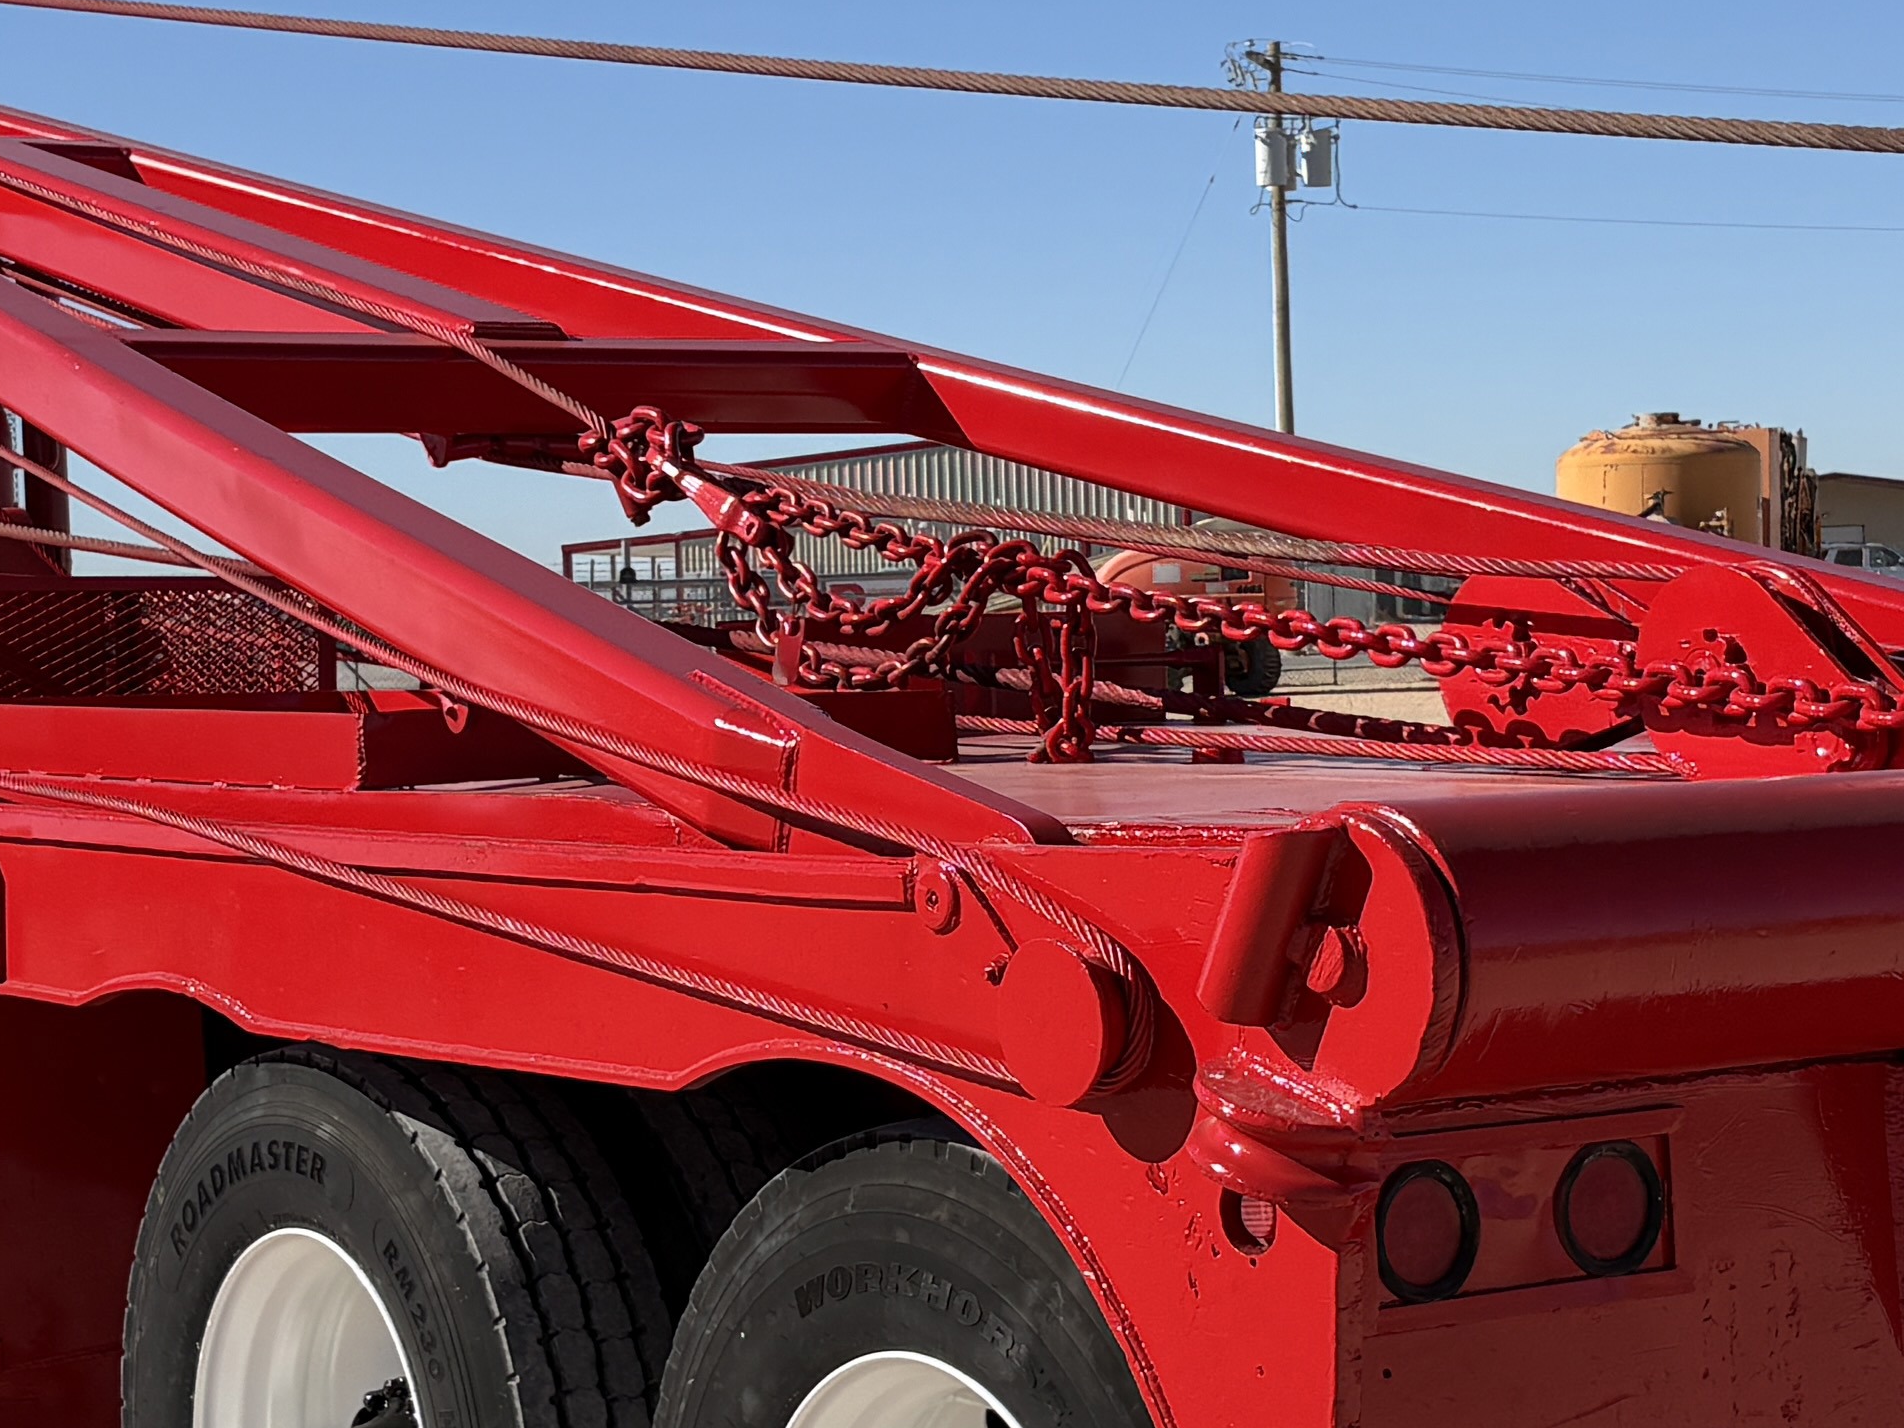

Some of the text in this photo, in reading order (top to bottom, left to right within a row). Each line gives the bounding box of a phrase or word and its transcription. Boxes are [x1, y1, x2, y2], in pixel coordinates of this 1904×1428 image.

[170, 1138, 327, 1259] ROADMASTER
[383, 1239, 444, 1383] RM230
[794, 1262, 1074, 1428] WORKHORSE
